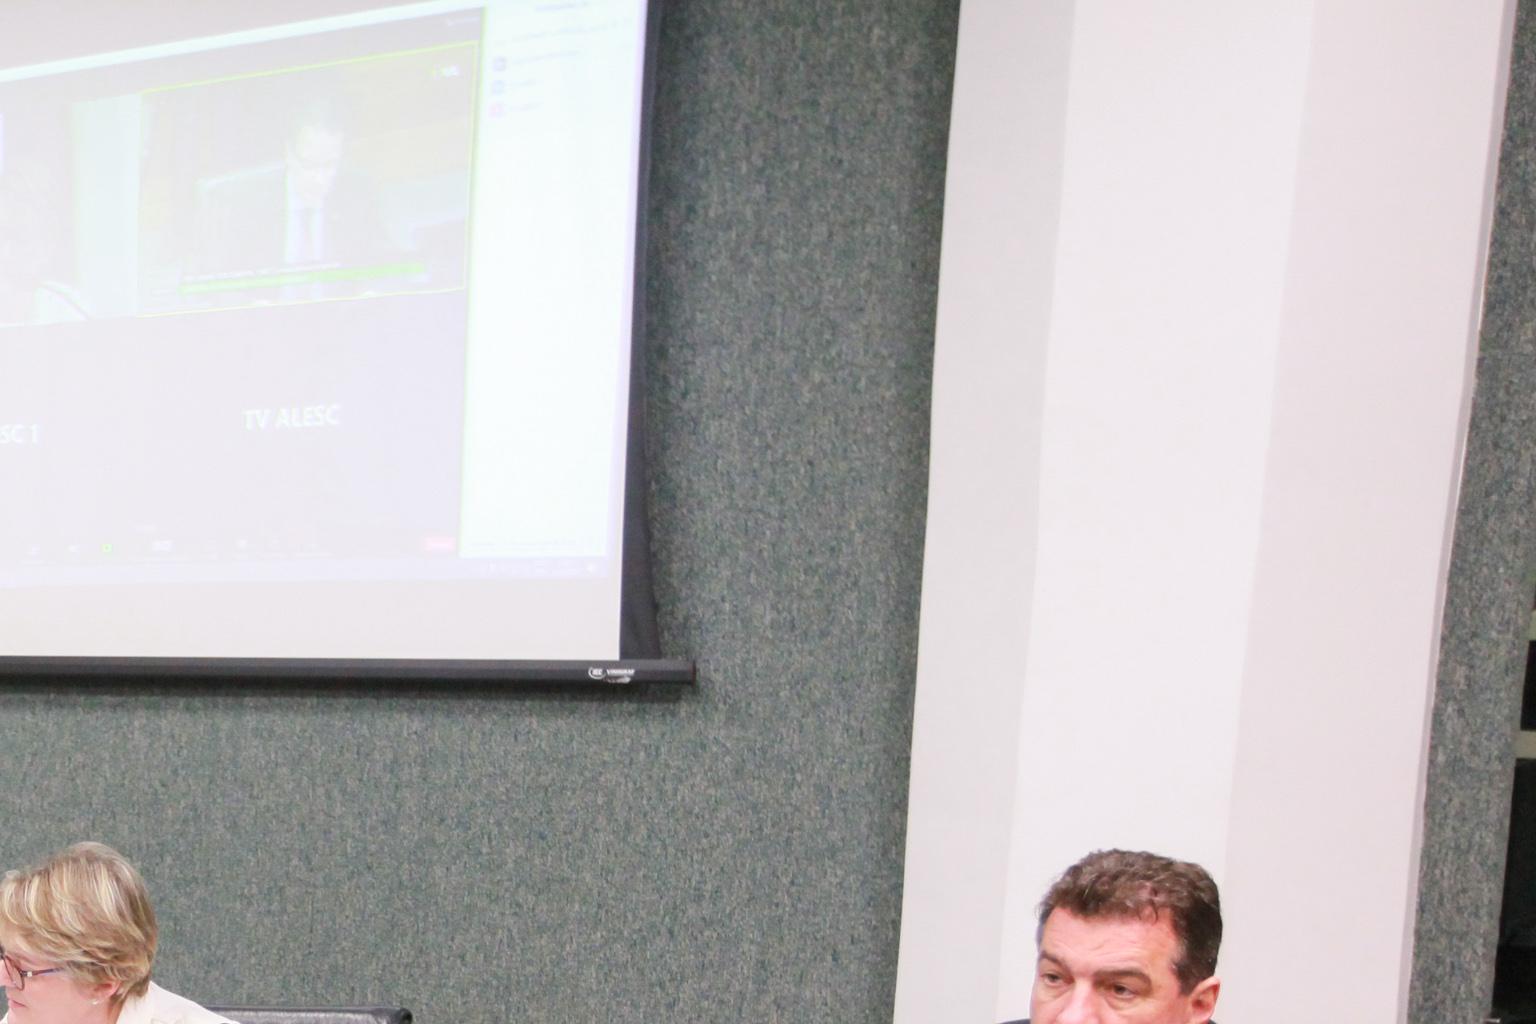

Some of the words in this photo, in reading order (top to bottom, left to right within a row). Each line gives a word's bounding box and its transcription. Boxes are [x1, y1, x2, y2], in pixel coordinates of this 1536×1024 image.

[241, 408, 272, 430] TV
[274, 403, 343, 429] ALESC
[28, 423, 42, 444] 1
